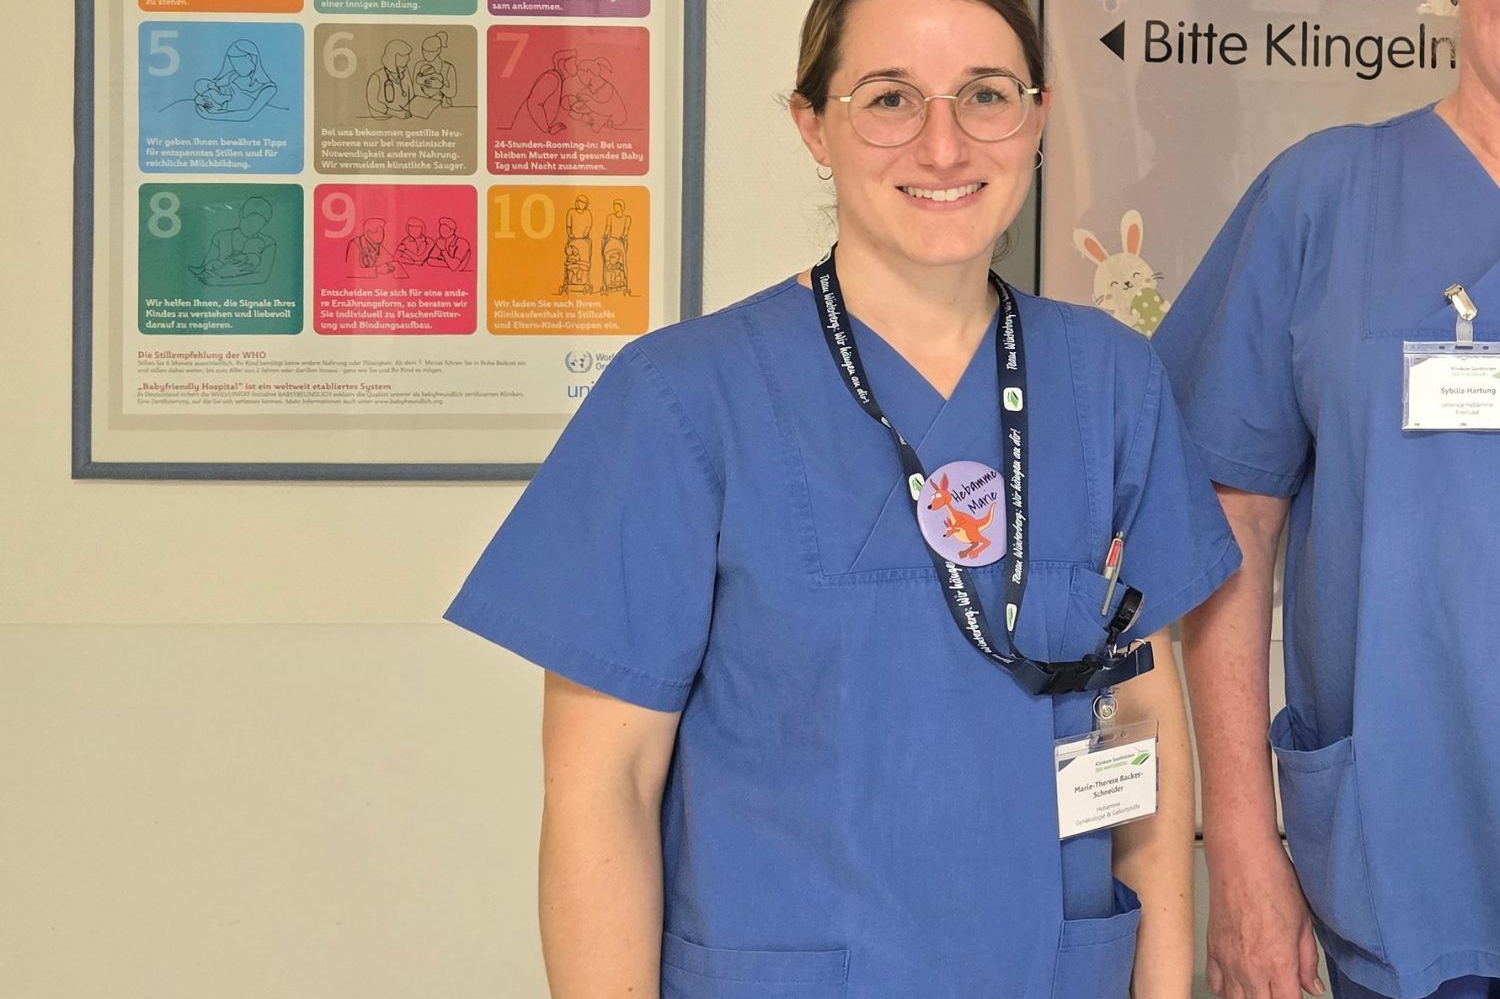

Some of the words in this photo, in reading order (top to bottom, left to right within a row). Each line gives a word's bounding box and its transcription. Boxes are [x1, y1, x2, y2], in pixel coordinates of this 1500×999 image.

[148, 30, 181, 76] 5
[324, 32, 357, 79] 6
[496, 33, 529, 78] 7
[1144, 20, 1248, 67] Bitte
[1266, 20, 1457, 81] Klingeln
[601, 140, 615, 149] Bei
[494, 150, 526, 159] bleiben
[528, 150, 558, 159] Mutter
[560, 151, 577, 160] und
[579, 151, 620, 162] gesundes
[621, 151, 644, 162] Baby
[494, 161, 510, 172] Tag
[512, 161, 529, 170] und
[530, 161, 556, 170] Nacht
[148, 192, 181, 238] 8
[322, 192, 355, 238] 9
[494, 193, 556, 239] 10
[145, 298, 162, 307] Wir
[164, 298, 191, 307] helfen
[193, 298, 221, 310] Ihnen,
[223, 298, 238, 307] die
[239, 298, 272, 310] Signale
[274, 298, 296, 307] Ihres
[145, 309, 176, 318] Kindes
[190, 309, 233, 318] verstehen
[234, 309, 252, 318] und
[253, 309, 291, 318] liebevoll
[145, 320, 174, 328] darauf
[176, 321, 187, 329] zu
[189, 320, 234, 331] reagieren.
[137, 351, 152, 359] Die
[154, 351, 223, 361] Stillempfehlung
[225, 351, 240, 359] der
[245, 382, 256, 390] ist
[273, 382, 310, 390] weltweit
[312, 382, 358, 390] etabliertes
[360, 383, 392, 392] System
[951, 470, 997, 503] Hebamme
[967, 490, 998, 515] Marie
[1074, 777, 1118, 793] Marie-Therese
[1093, 786, 1124, 798] Schneider
